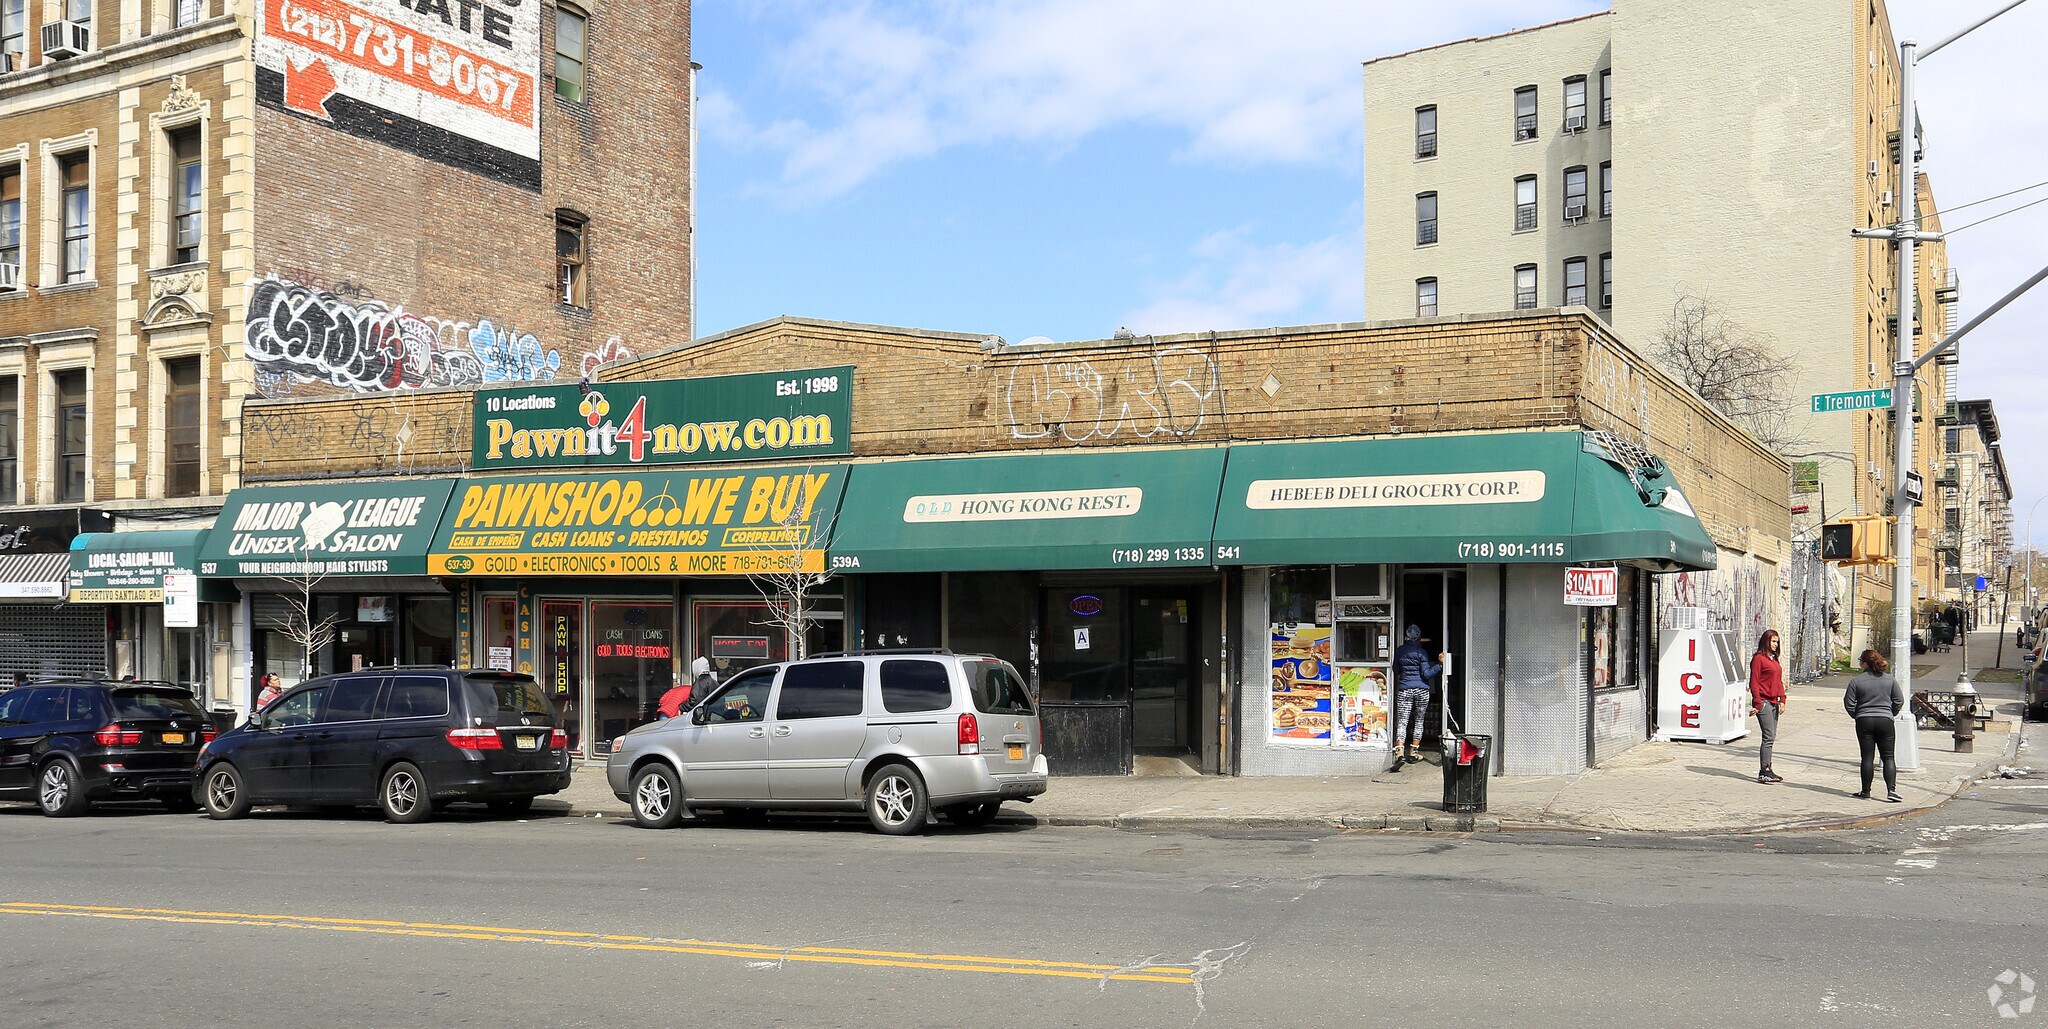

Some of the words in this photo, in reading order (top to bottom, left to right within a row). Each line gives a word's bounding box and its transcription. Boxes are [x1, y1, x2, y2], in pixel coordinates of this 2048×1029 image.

[279, 0, 346, 52] (212)
[349, 12, 520, 111] 731-9067
[776, 379, 801, 396] Est.
[804, 376, 839, 394] 1998
[485, 396, 501, 412] 10
[502, 394, 556, 411] Locations
[1814, 396, 1820, 411] E
[1825, 392, 1876, 411] Tremont
[1270, 487, 1334, 501] HEBEEB
[1338, 485, 1378, 499] DELI
[1382, 483, 1465, 499] GROCERY
[1468, 481, 1520, 496] CORP.
[454, 479, 643, 528] PAWNSHOP
[682, 476, 745, 525] WE
[742, 473, 830, 524] BUY
[916, 501, 952, 516] OLD
[960, 500, 1014, 514] HONG
[1019, 497, 1073, 513] KONG
[1077, 494, 1131, 511] REST.
[232, 501, 305, 532] MAJOR
[347, 496, 426, 529] LEAGUE
[228, 532, 300, 556] UNISEX
[328, 530, 403, 553] SALON
[453, 536, 473, 546] CASA
[476, 536, 486, 546] DE
[488, 533, 519, 546] EMPEÑO
[531, 531, 569, 548] CASH
[570, 531, 615, 547] LOANS
[627, 530, 709, 547] PRESTAMOS
[732, 530, 800, 543] COMPRAMOS
[832, 556, 860, 568] 539A
[1112, 548, 1144, 563] (718)
[1146, 549, 1169, 562] 299
[1174, 547, 1204, 561] 1335
[1217, 546, 1240, 558] 541
[1458, 541, 1494, 558] (718)
[1498, 542, 1564, 557] 901-1115
[88, 551, 175, 568] LOCAL-SALON-HALL
[201, 562, 217, 574] 537
[238, 562, 260, 574] YOUR
[261, 561, 324, 574] NEIGHBORHOOD
[326, 561, 346, 573] HAIR
[348, 559, 388, 573] STYLISTS
[447, 559, 473, 569] 537-39
[484, 557, 518, 573] GOLD
[531, 556, 606, 572] ELECTRONICS
[620, 555, 660, 572] TOOLS
[669, 556, 679, 571] &
[688, 555, 727, 571] MORE
[110, 569, 134, 577] Birthdays
[1567, 572, 1584, 592] $10
[1583, 571, 1614, 596] ATM
[80, 590, 113, 600] DEPORTIVO
[115, 590, 146, 600] SANTIAGO
[1070, 600, 1103, 610] OPEN
[520, 587, 530, 649] CASH
[557, 616, 567, 647] PAWN
[606, 630, 623, 640] CASH
[643, 629, 663, 640] LOANS
[1077, 631, 1087, 644] A
[597, 645, 612, 657] GOLD
[616, 644, 633, 656] TOOLS
[558, 662, 567, 692] SHOP
[1680, 639, 1703, 729] ICE
[1728, 696, 1742, 721] ICE
